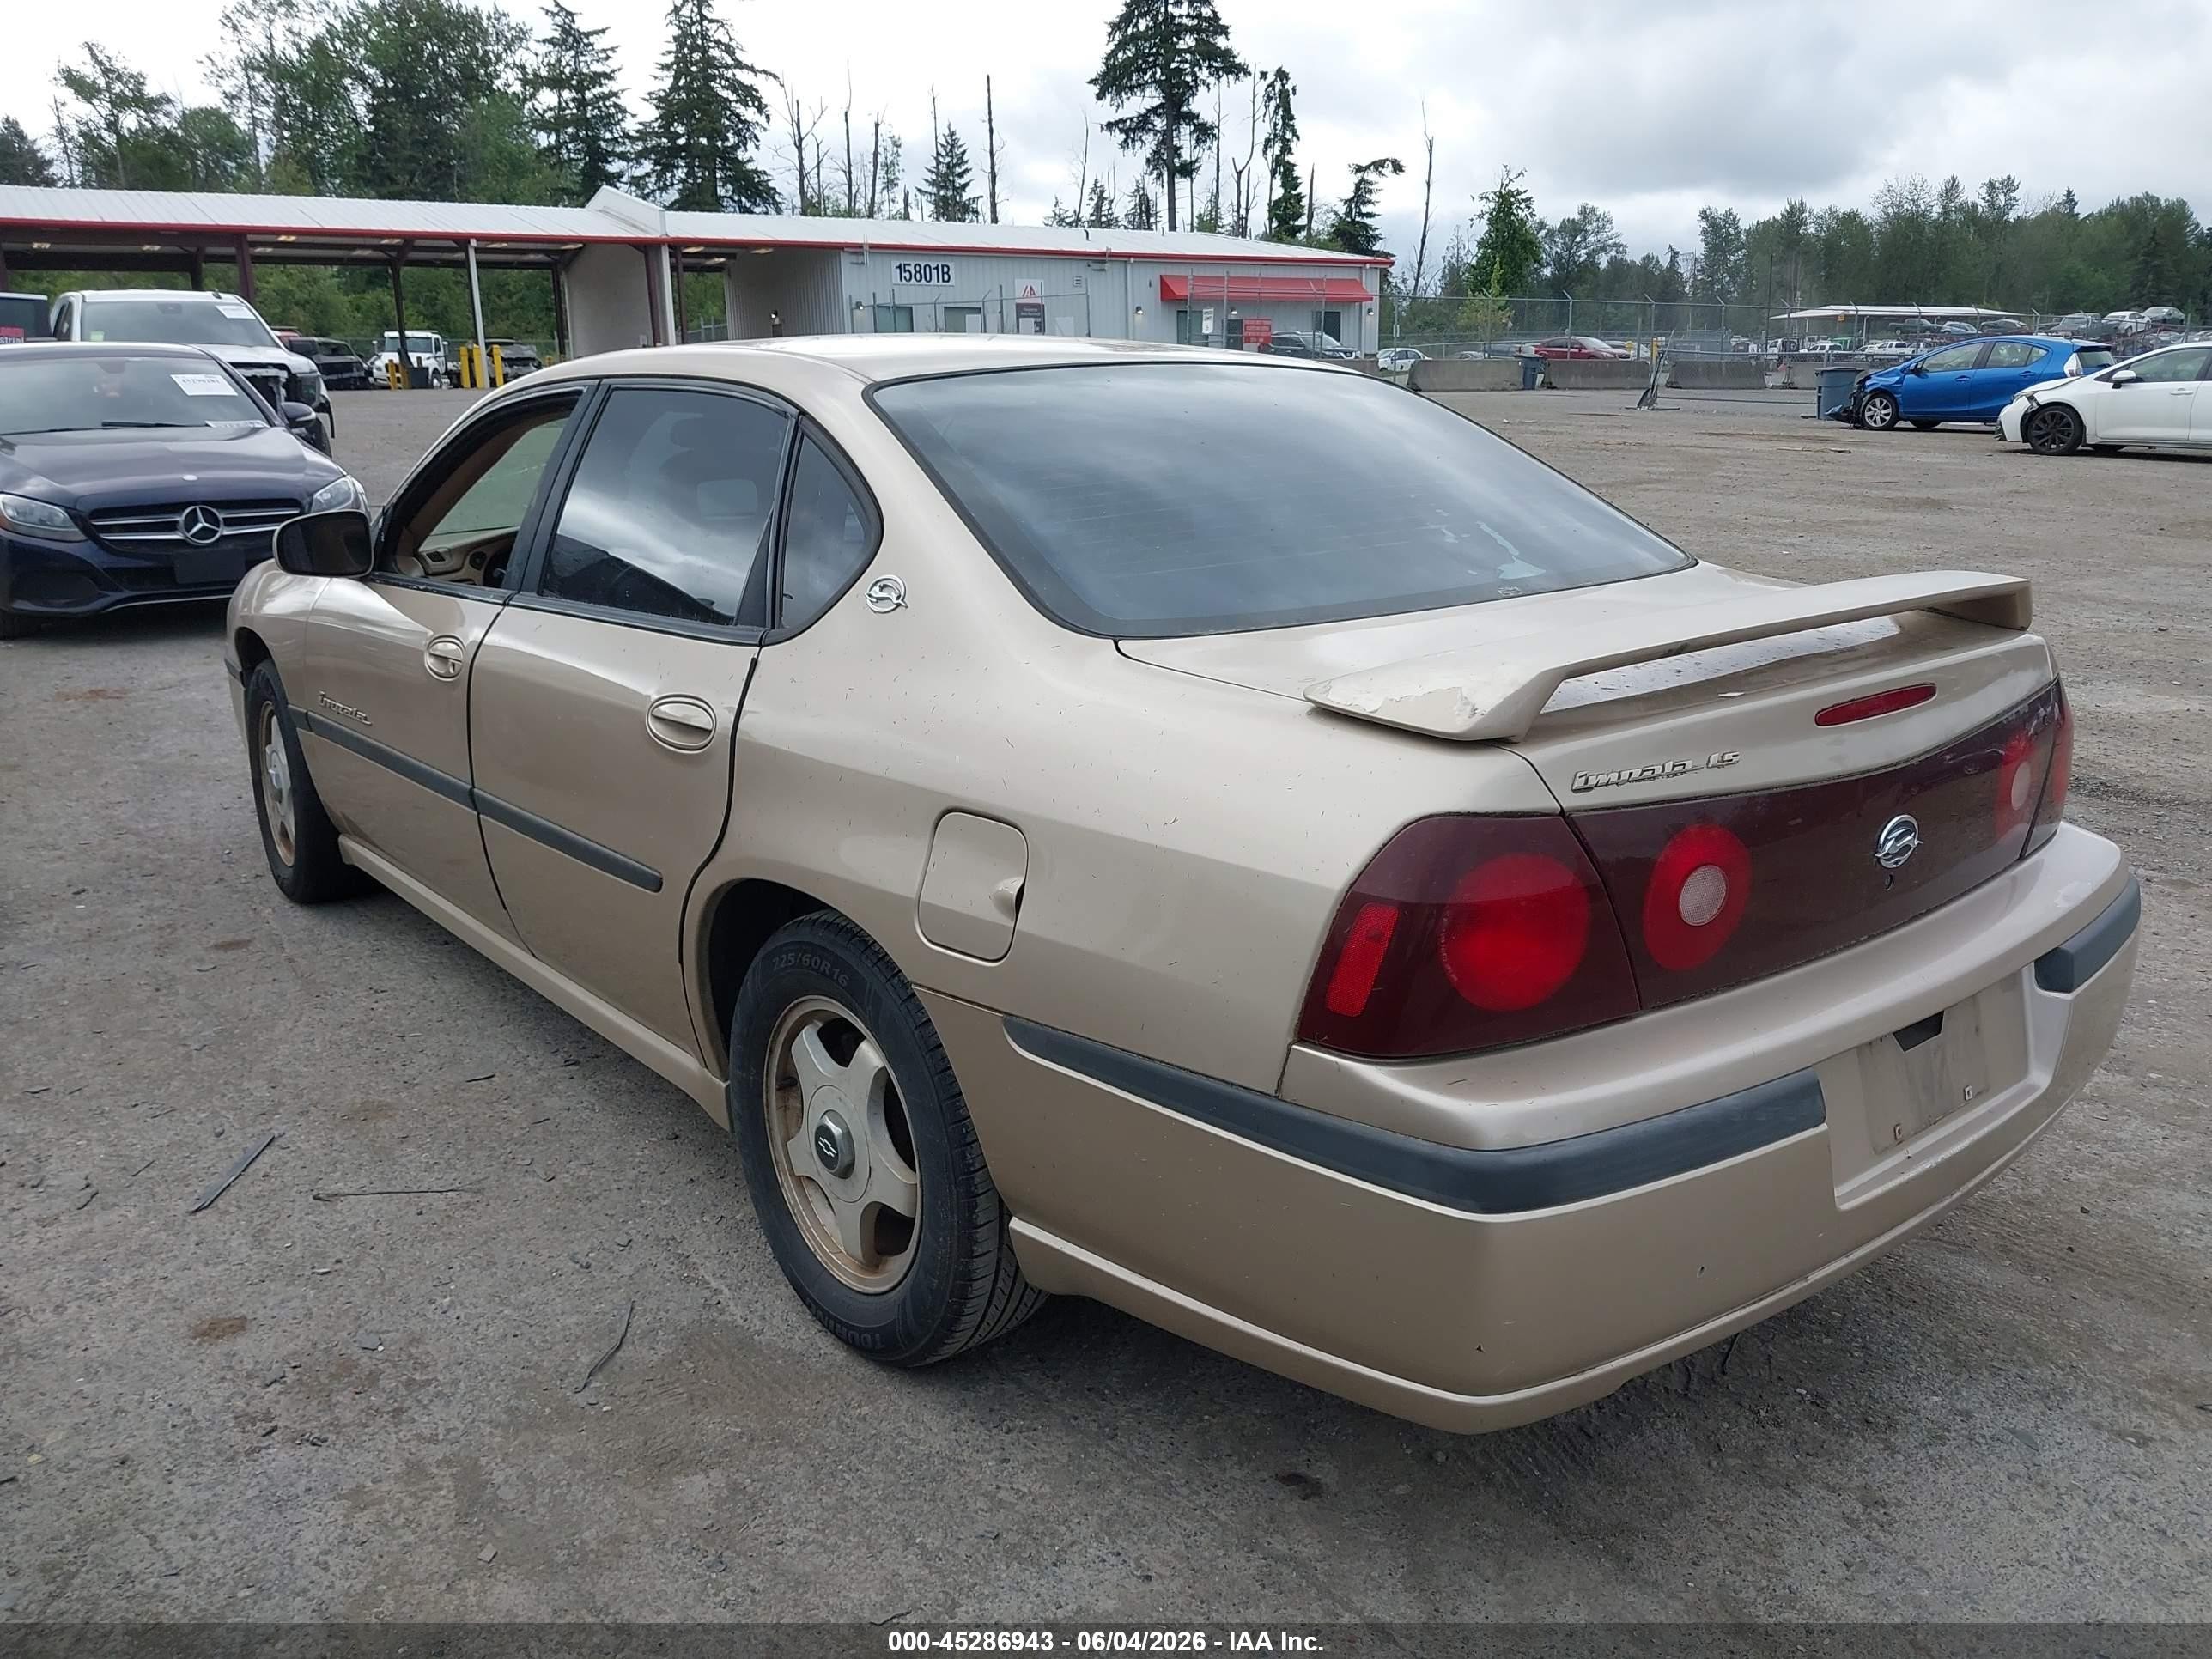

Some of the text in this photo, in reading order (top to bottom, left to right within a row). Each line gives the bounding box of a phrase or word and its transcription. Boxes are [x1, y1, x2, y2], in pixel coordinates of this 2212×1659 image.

[895, 263, 951, 283] 15801B
[318, 690, 372, 726] Impala
[1571, 751, 1741, 793] Impala LS
[773, 952, 850, 988] 225/60R16
